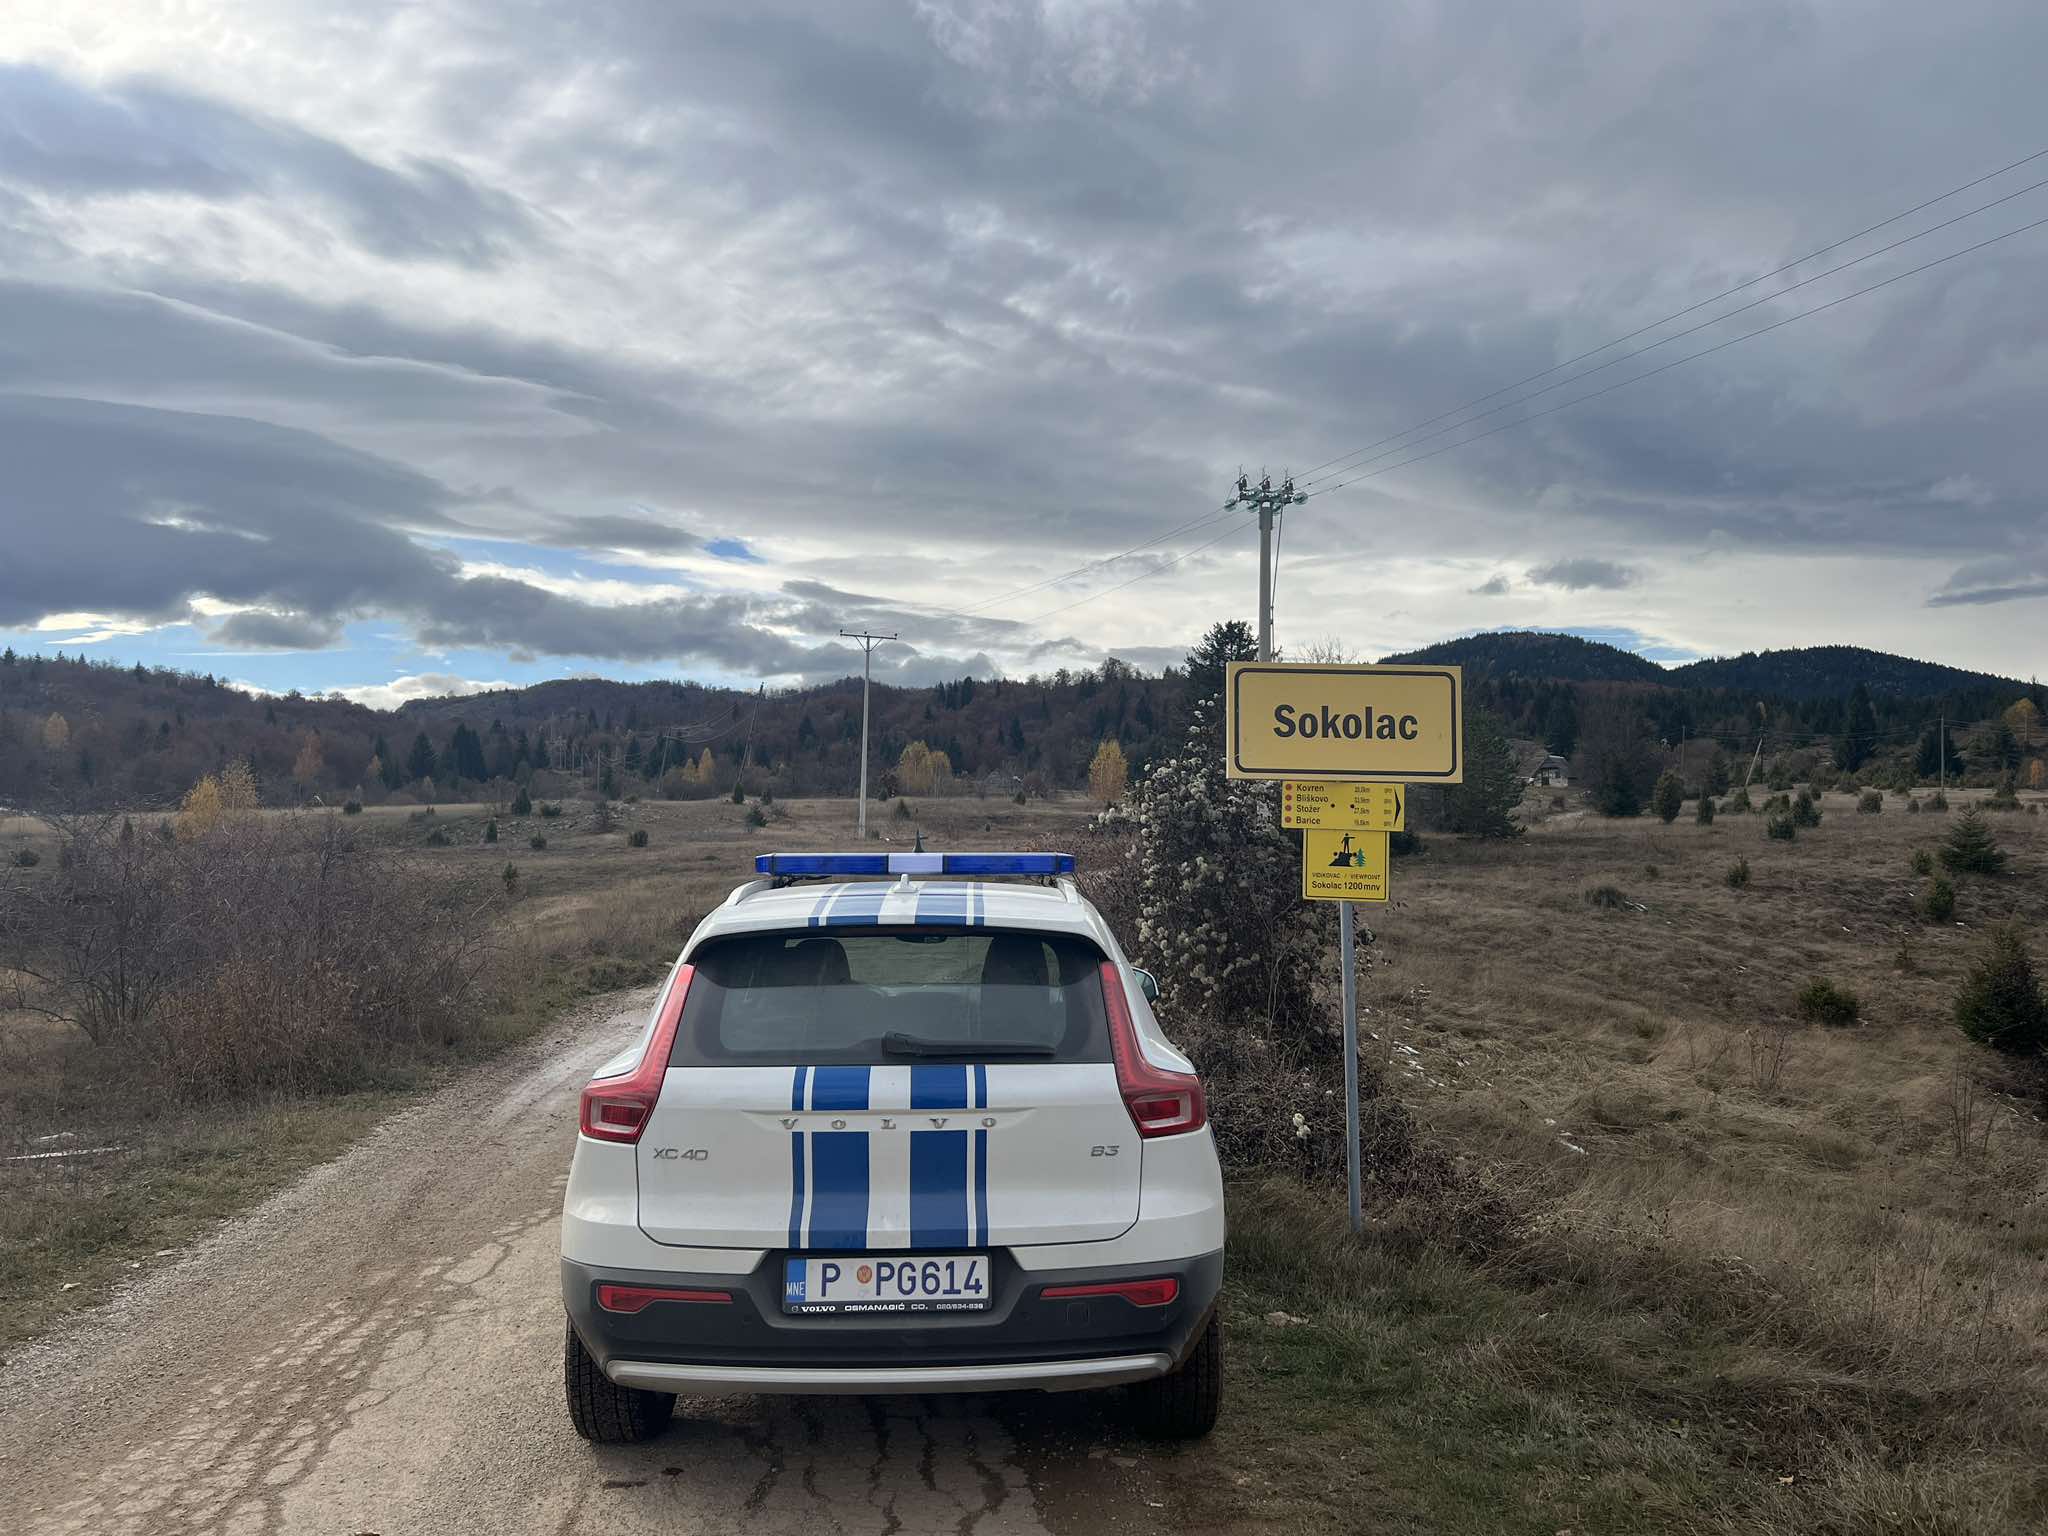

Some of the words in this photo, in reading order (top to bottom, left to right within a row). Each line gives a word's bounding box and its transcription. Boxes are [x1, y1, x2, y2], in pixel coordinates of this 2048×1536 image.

[1272, 704, 1419, 741] Sokolac
[1296, 784, 1325, 793] Kovren
[1296, 805, 1321, 814] Stožer
[1296, 816, 1321, 825] Barice
[1312, 881, 1342, 890] Sokolac
[1344, 882, 1363, 890] 1200
[779, 1117, 998, 1131] VOLVO
[1090, 1145, 1120, 1157] B3
[821, 1263, 841, 1297] P
[875, 1260, 983, 1296] PG614
[786, 1281, 805, 1296] MNE
[844, 1303, 905, 1312] OSMANAGIĆ
